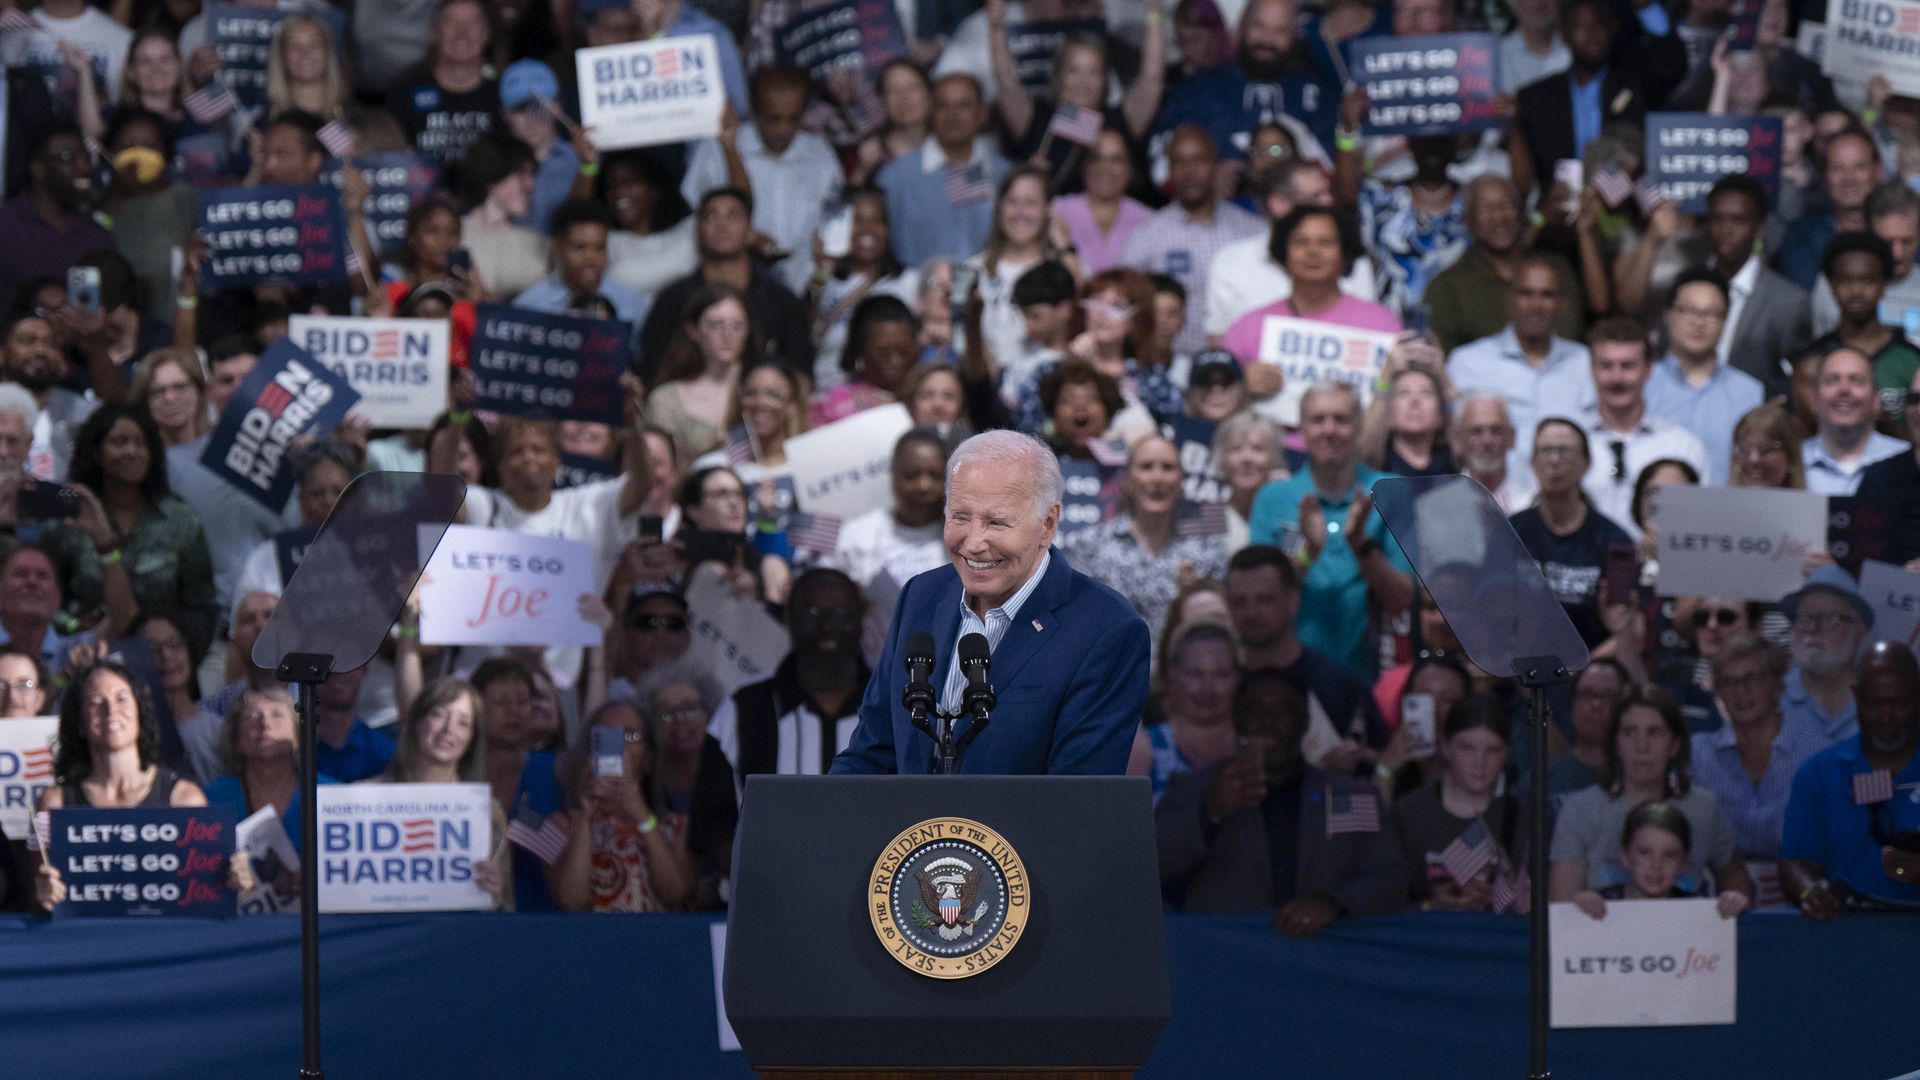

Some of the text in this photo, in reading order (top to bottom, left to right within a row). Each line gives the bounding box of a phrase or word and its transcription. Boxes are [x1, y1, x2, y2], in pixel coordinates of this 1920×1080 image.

[595, 47, 705, 83] BIDEN
[1364, 51, 1424, 74] LET'S
[1424, 48, 1458, 69] GO
[597, 76, 709, 108] HARRIS
[1366, 78, 1426, 100] LET'S
[1426, 75, 1460, 97] GO
[1369, 104, 1428, 127] LET'S
[1428, 102, 1462, 122] GO
[1659, 127, 1718, 147] LET'S
[1718, 127, 1749, 147] GO
[376, 167, 408, 188] GO
[1659, 154, 1718, 174] LET'S
[1718, 154, 1749, 174] GO
[207, 200, 262, 223] LET'S
[262, 199, 296, 220] GO
[377, 194, 410, 214] GO
[206, 228, 265, 250] LET'S
[265, 226, 299, 247] GO
[212, 255, 270, 276] LET'S
[270, 253, 303, 273] GO
[305, 328, 430, 358] BIDEN
[485, 318, 546, 346] LET'S
[547, 328, 583, 349] GO
[332, 360, 430, 385] ARRIS
[479, 348, 542, 375] LET'S
[543, 357, 580, 379] GO
[475, 378, 538, 404] LET'S
[539, 386, 574, 408] GO
[224, 358, 314, 479] BIDEN
[249, 378, 334, 492] HARRIS
[806, 466, 863, 500] LET'S
[1065, 475, 1100, 497] GO
[1065, 503, 1100, 524] GO
[1669, 532, 1734, 552] LET'S
[1738, 536, 1774, 555] GO
[452, 552, 564, 575] LET'S GO
[465, 574, 549, 629] Joe
[321, 803, 372, 816] NORTH
[376, 802, 449, 816] CAROLINA
[67, 816, 223, 848] LET'S GO Joe
[323, 819, 471, 854] BIDEN
[68, 847, 223, 878] LET'S GO Joe
[324, 856, 473, 884] HARRIS
[69, 883, 140, 902] LET'S
[142, 883, 180, 901] GO
[178, 877, 221, 907] Joe
[874, 823, 1025, 972] SEAL OF THE PRESIDENT OF THE UNITED STATES
[1564, 947, 1722, 979] LET'S GO Joe
